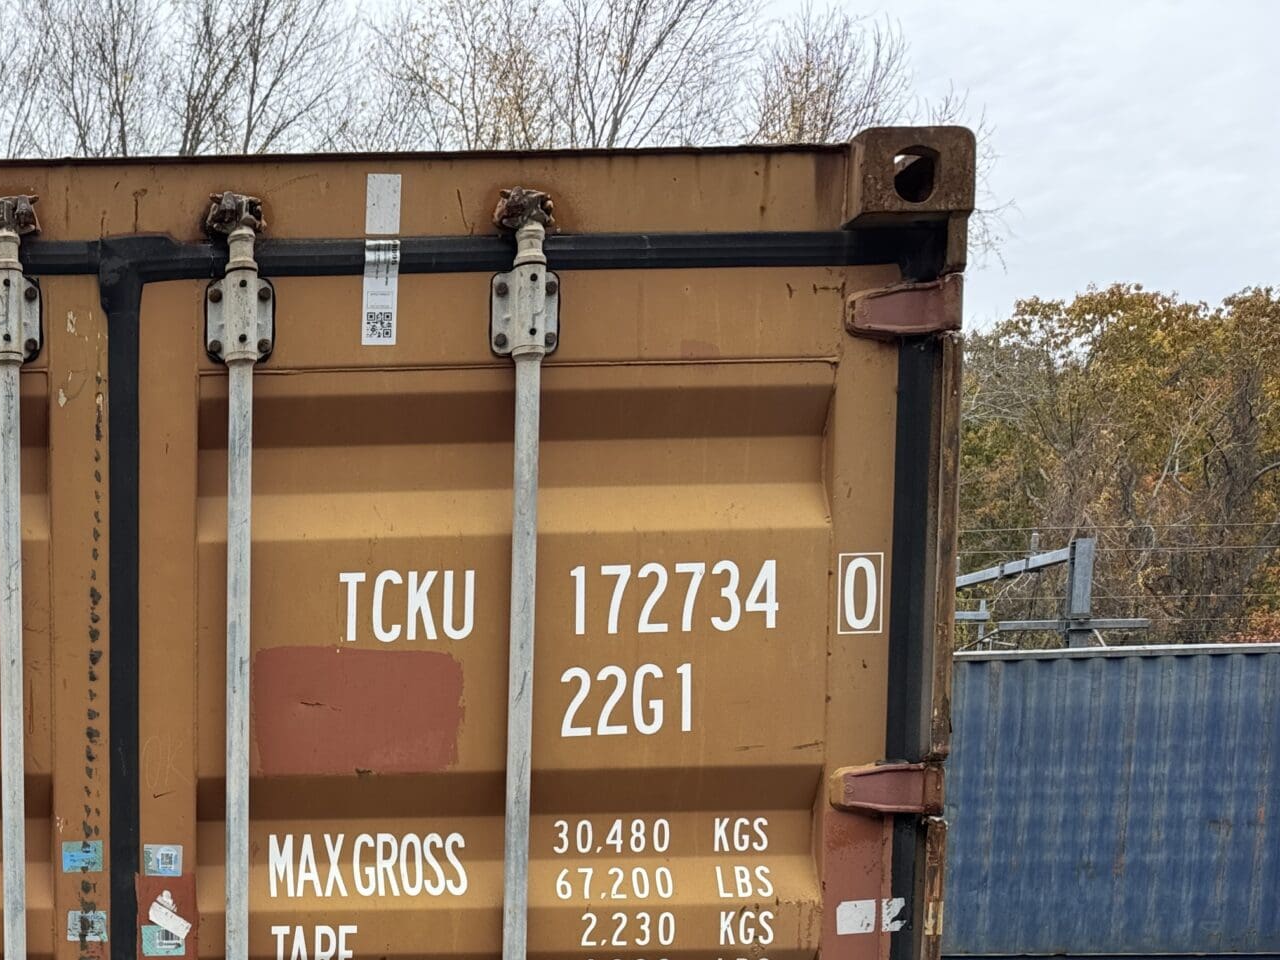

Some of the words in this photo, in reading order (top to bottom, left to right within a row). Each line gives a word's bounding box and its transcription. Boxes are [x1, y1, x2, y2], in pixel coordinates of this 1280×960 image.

[340, 570, 475, 643] TCKU
[569, 560, 779, 635] 172734
[844, 557, 878, 630] 0
[560, 663, 692, 737] 22G1
[552, 819, 671, 855] 30,480
[714, 817, 769, 852] KGS
[269, 833, 348, 898] MAX
[353, 832, 468, 897] GROSS
[555, 866, 674, 901] 67,200
[716, 866, 774, 899] LBS
[581, 912, 676, 948] 2,230
[719, 911, 774, 946] KGS
